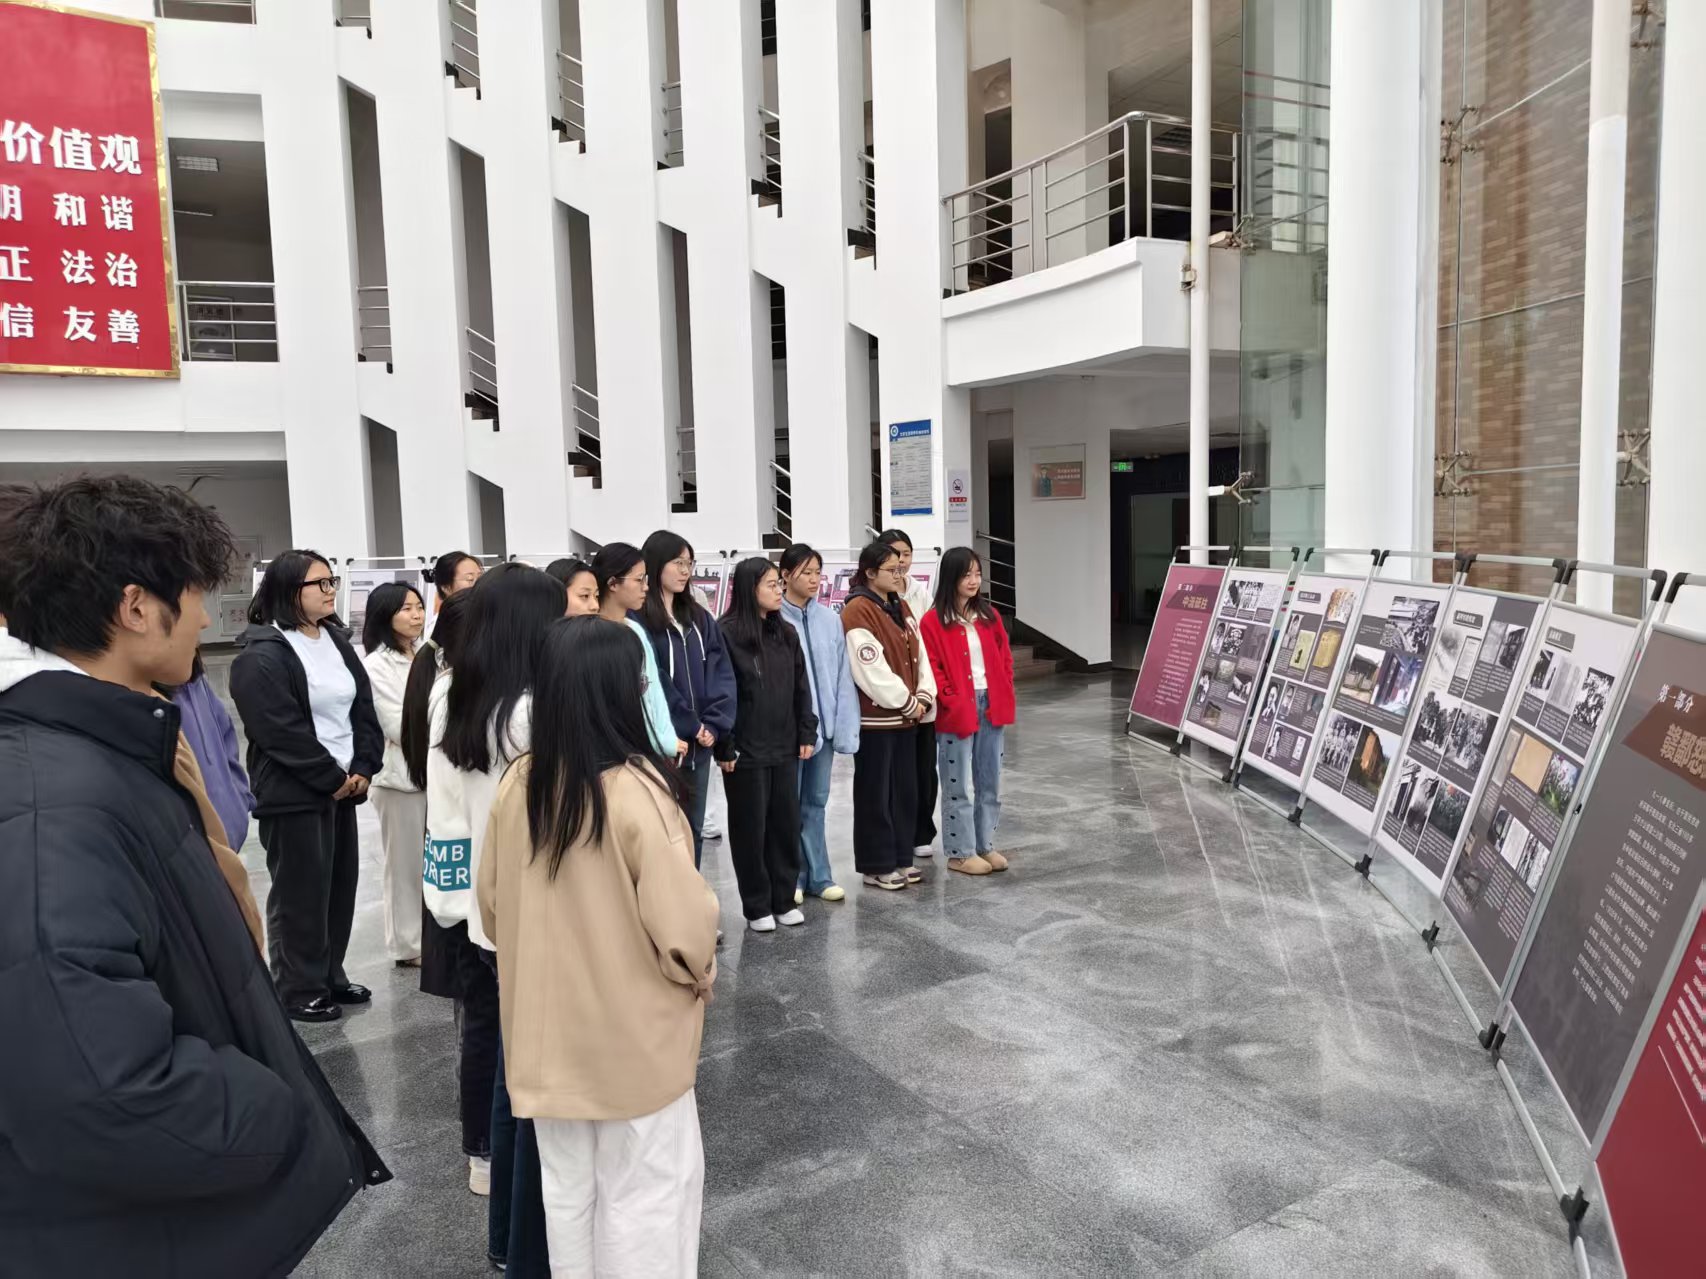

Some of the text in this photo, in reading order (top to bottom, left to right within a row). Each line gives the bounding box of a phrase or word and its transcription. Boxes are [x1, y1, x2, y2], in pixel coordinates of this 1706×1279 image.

[0, 119, 142, 175] 价值观
[53, 192, 134, 232] 和谐
[0, 245, 138, 288] 正 法治
[0, 302, 140, 344] 信 友善
[1658, 684, 1694, 713] 第一部分
